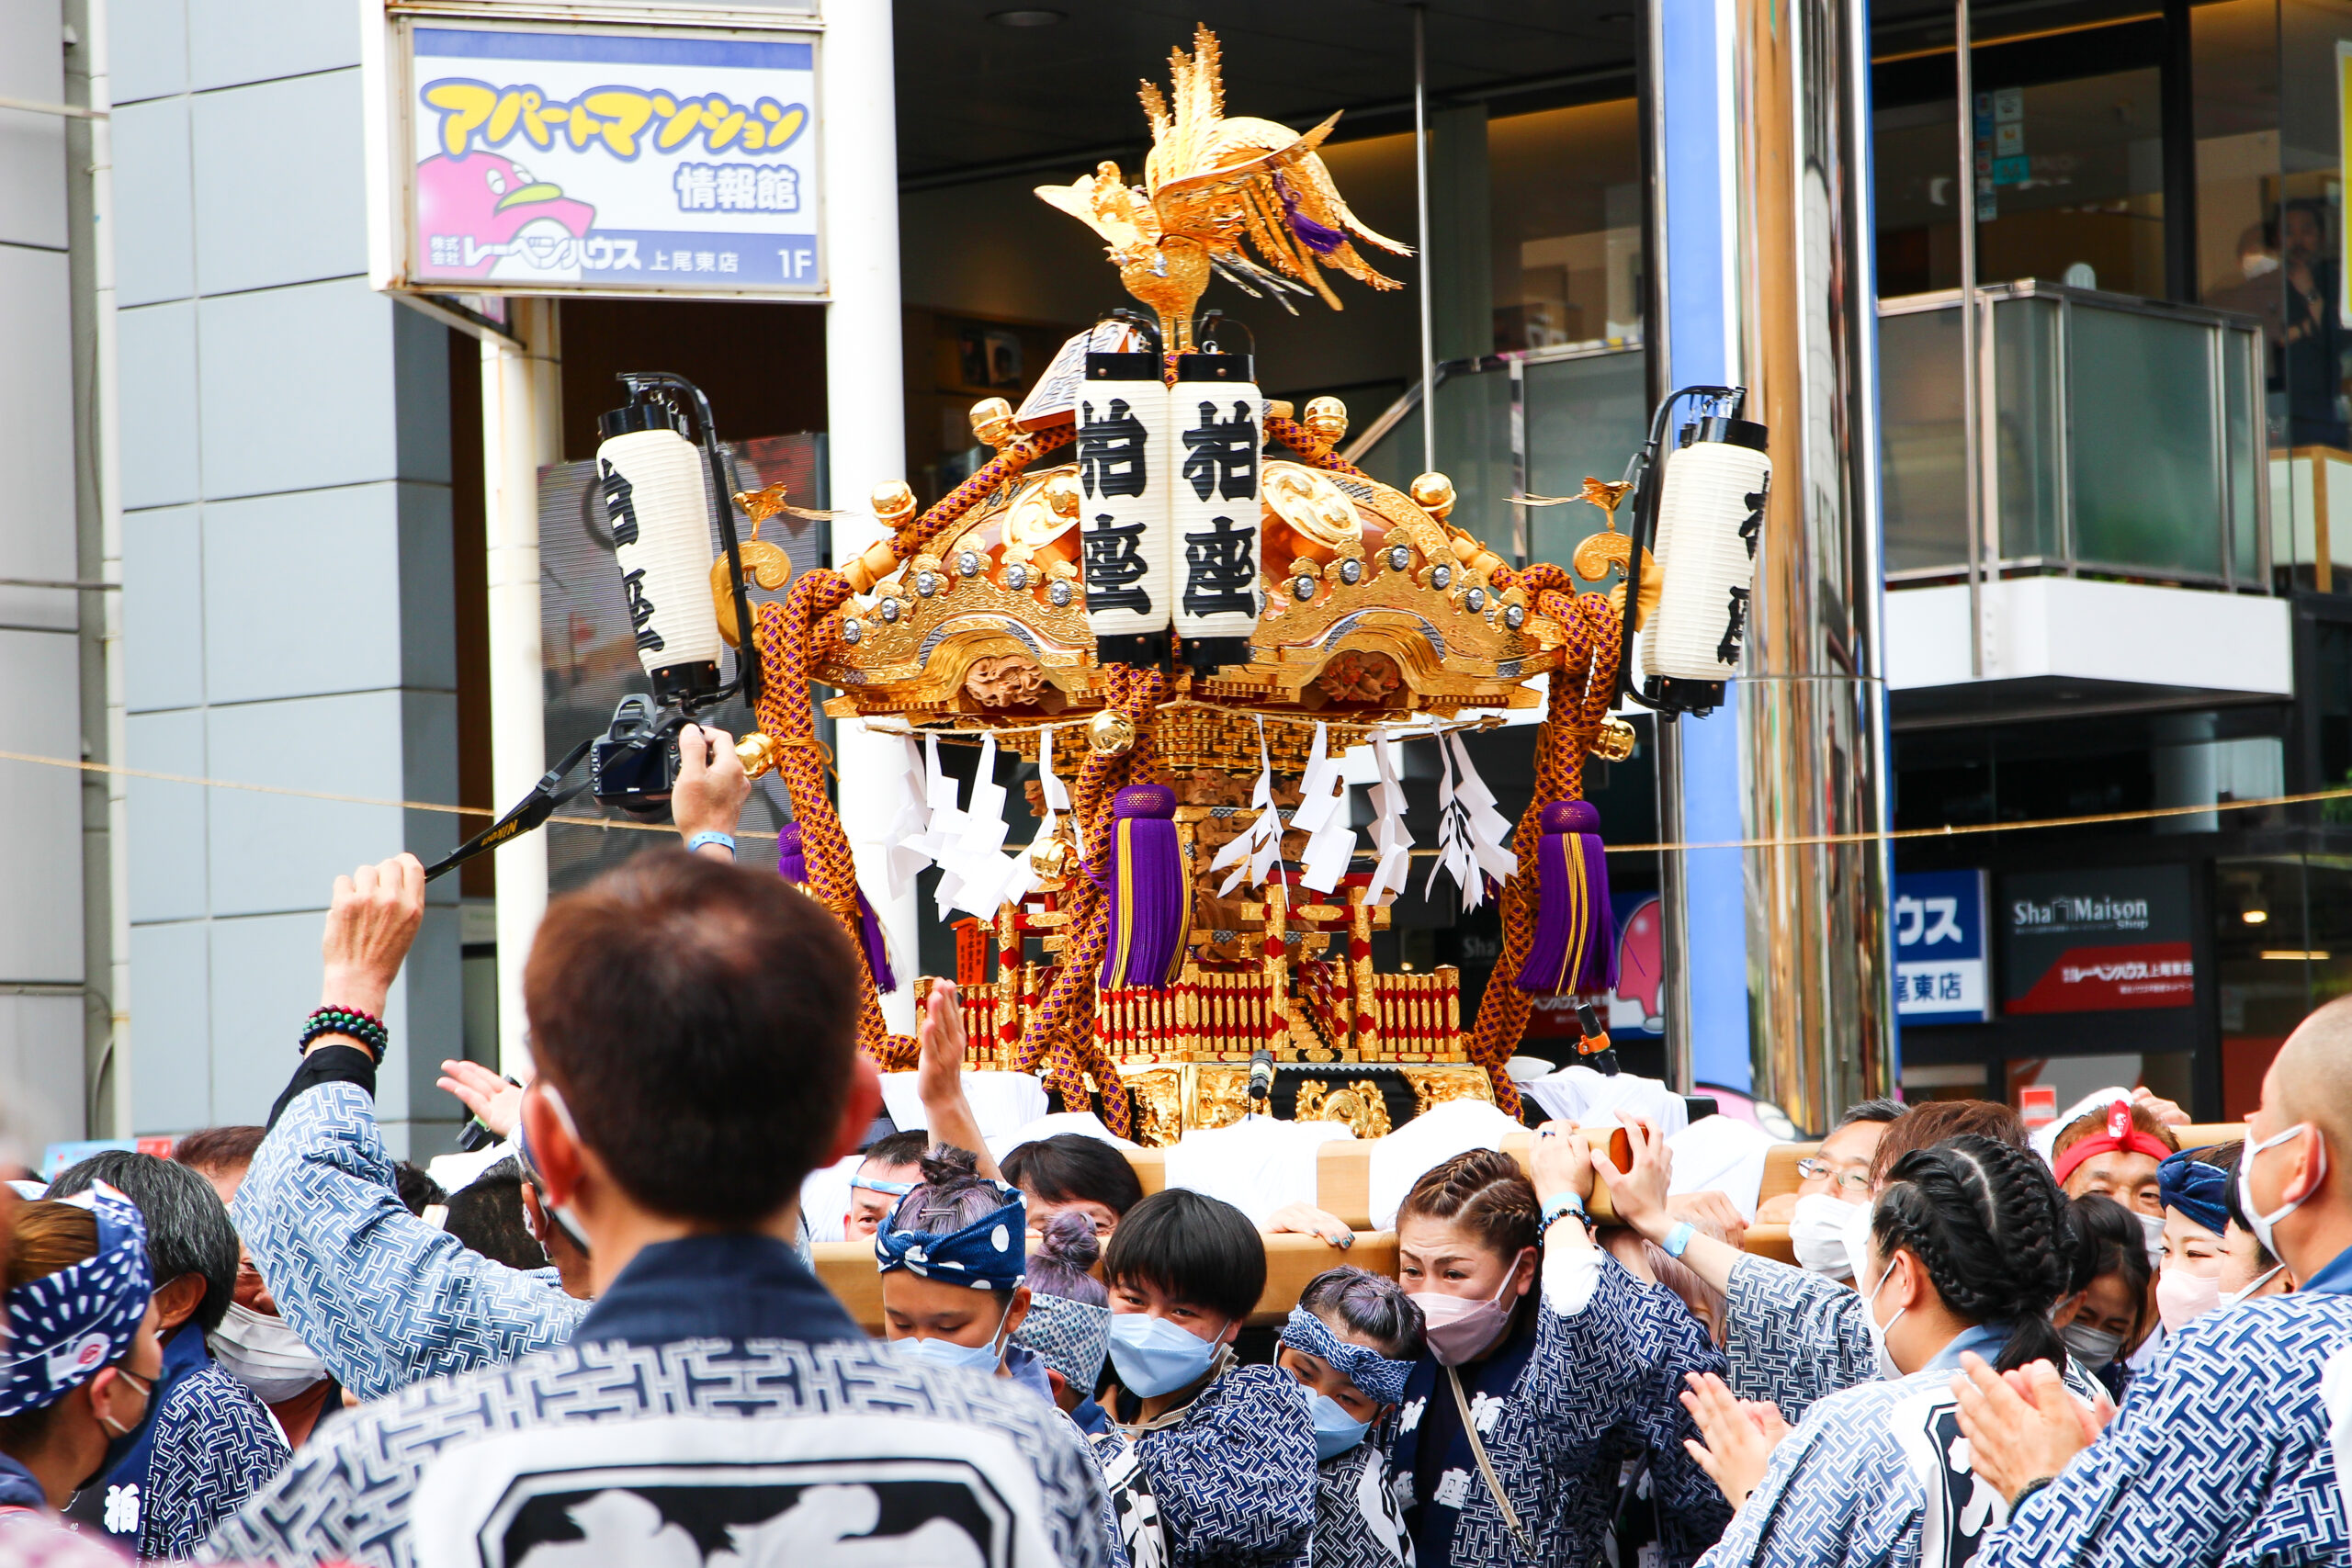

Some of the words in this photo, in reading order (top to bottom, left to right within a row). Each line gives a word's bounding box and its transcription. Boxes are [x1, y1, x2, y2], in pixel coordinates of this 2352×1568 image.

[423, 82, 806, 159] アパートマンション
[677, 164, 797, 211] 情報館
[649, 250, 739, 274] 上尾東店
[777, 249, 812, 278] 1F
[1182, 400, 1258, 619] 柏座
[481, 819, 518, 847] Nikon
[2014, 900, 2051, 926] Sha
[2074, 896, 2148, 922] Maison
[2116, 919, 2149, 931] Shop
